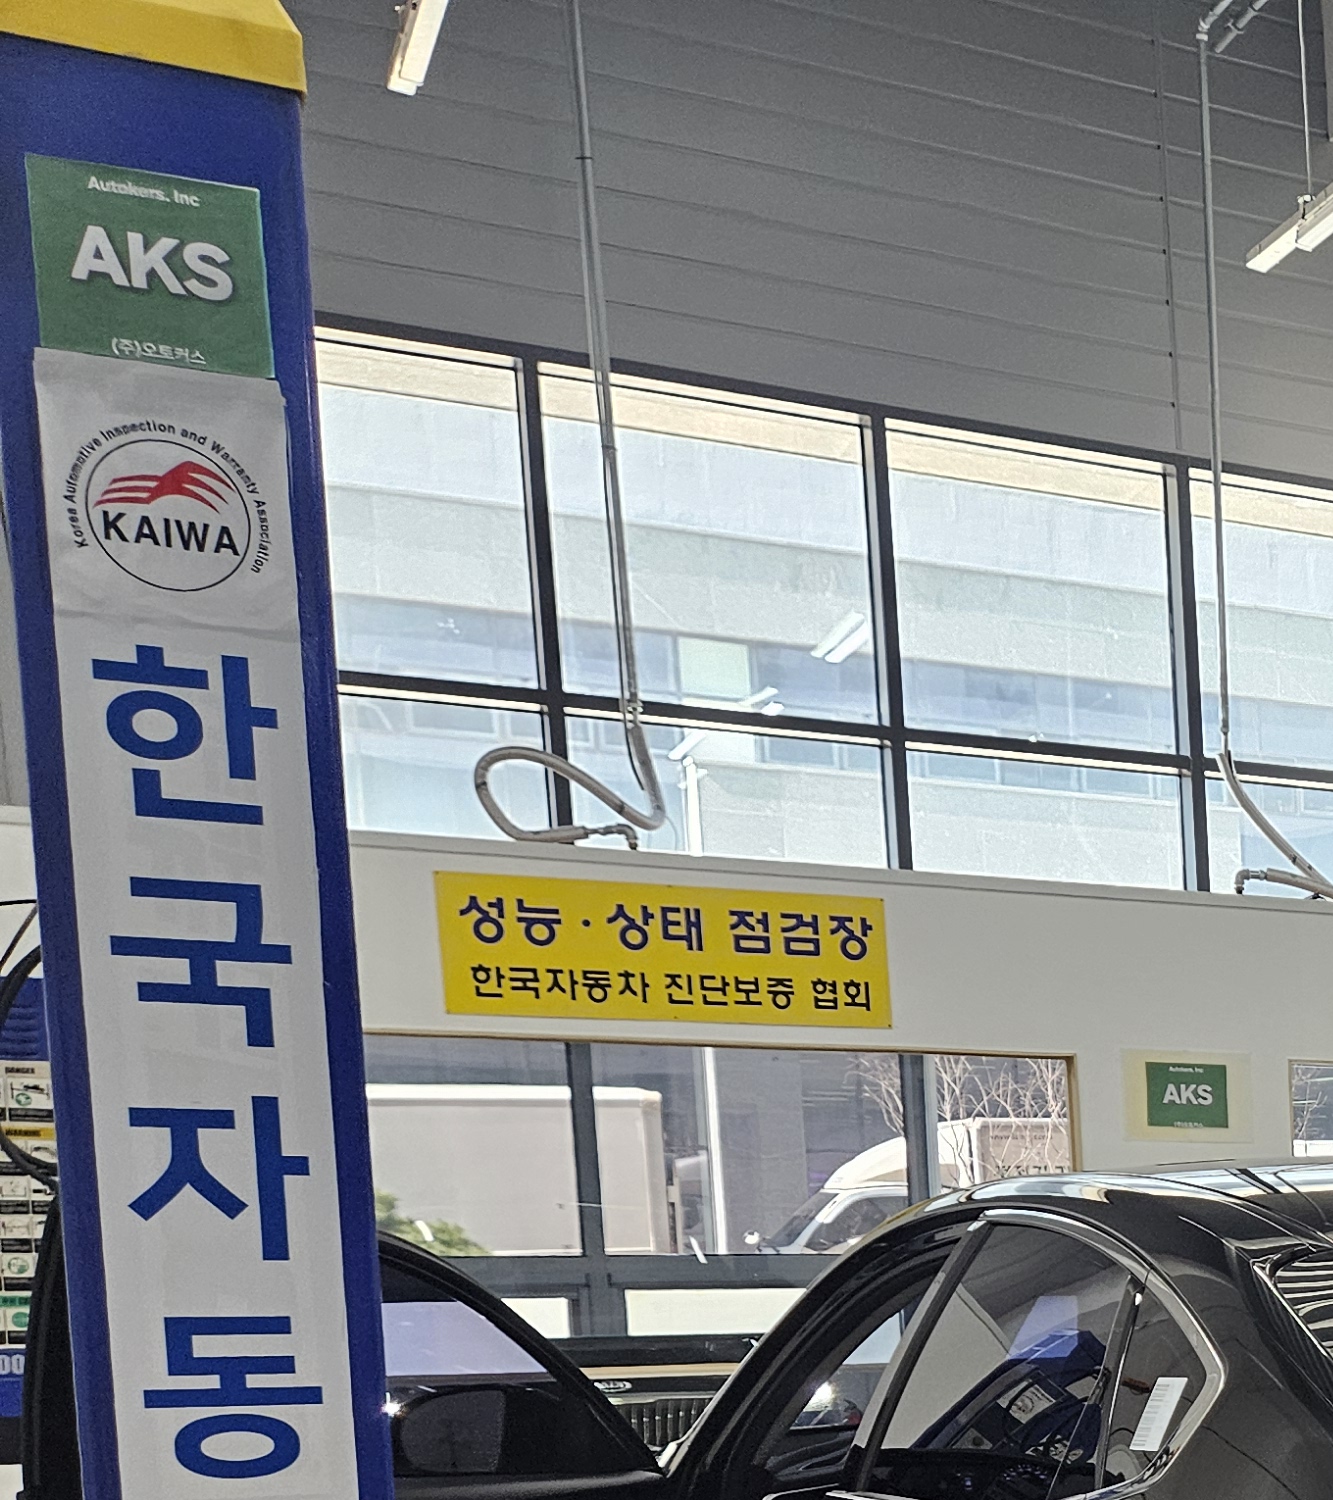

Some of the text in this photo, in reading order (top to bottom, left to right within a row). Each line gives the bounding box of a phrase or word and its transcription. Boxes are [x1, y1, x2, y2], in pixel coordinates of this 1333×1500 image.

[173, 189, 201, 207] Inc
[70, 224, 233, 302] AKS
[112, 337, 206, 365] (주)오토커스
[63, 419, 274, 575] Korea Automotive Inspection and Warranty Association
[101, 509, 241, 557] KAIWA
[728, 907, 873, 961] 점검장
[470, 963, 872, 1012] 한국자동차 진단보증 협회
[1162, 1083, 1214, 1106] AKS
